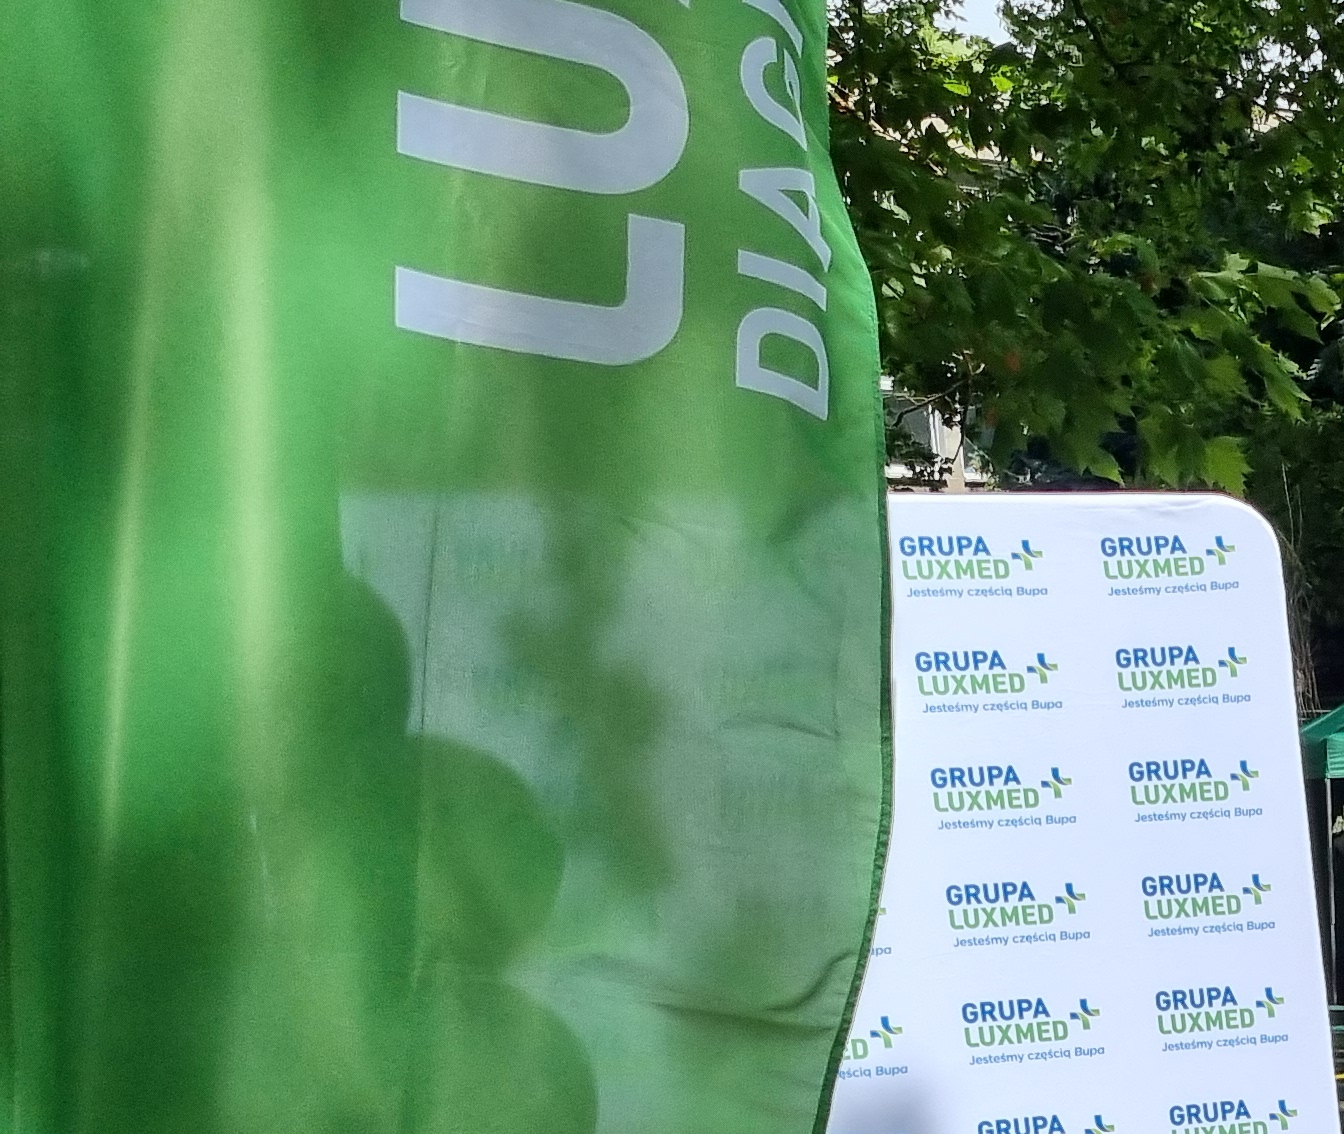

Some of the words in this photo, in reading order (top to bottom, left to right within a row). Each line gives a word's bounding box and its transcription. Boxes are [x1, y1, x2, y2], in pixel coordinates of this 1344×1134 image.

[899, 536, 991, 557] GRUPA
[1101, 535, 1187, 557] GRUPA
[902, 559, 1009, 580] LUXMED
[1103, 557, 1204, 579] LUXMED
[906, 587, 964, 599] Jesteśmy
[1016, 586, 1048, 597] Bupa
[1107, 585, 1162, 597] Jesteśmy
[1210, 580, 1240, 591] Bupa
[915, 650, 1007, 672] GRUPA
[1115, 645, 1200, 669] GRUPA
[918, 673, 1025, 696] LUXMED
[1118, 668, 1216, 691] LUXMED
[922, 702, 980, 714] Jesteśmy
[1031, 699, 1063, 711] Bupa
[1121, 696, 1175, 709] Jesteśmy
[1222, 693, 1252, 704] Bupa
[931, 765, 1021, 789] GRUPA
[1129, 758, 1212, 782] GRUPA
[933, 788, 1039, 812] LUXMED
[1131, 781, 1228, 805] LUXMED
[938, 818, 995, 830] Jesteśmy
[1045, 814, 1077, 826] Bupa
[1134, 810, 1187, 823] Jesteśmy
[1234, 806, 1263, 818] Bupa
[946, 881, 1036, 906] GRUPA
[1142, 872, 1225, 897] GRUPA
[949, 904, 1053, 929] LUXMED
[1144, 895, 1241, 920] LUXMED
[953, 935, 1009, 948] Jesteśmy
[1059, 930, 1091, 942] Bupa
[1147, 925, 1200, 938] Jesteśmy
[1246, 920, 1276, 931] Bupa
[1155, 986, 1238, 1011] GRUPA
[962, 998, 1051, 1024] GRUPA
[1158, 1008, 1254, 1034] LUXMED
[964, 1021, 1068, 1047] LUXMED
[1162, 1039, 1214, 1052] Jesteśmy
[1259, 1033, 1289, 1044] Bupa
[969, 1052, 1025, 1066] Jesteśmy
[1074, 1046, 1105, 1058] Bupa
[875, 1064, 909, 1078] Bupa
[1169, 1100, 1251, 1126] GRUPA
